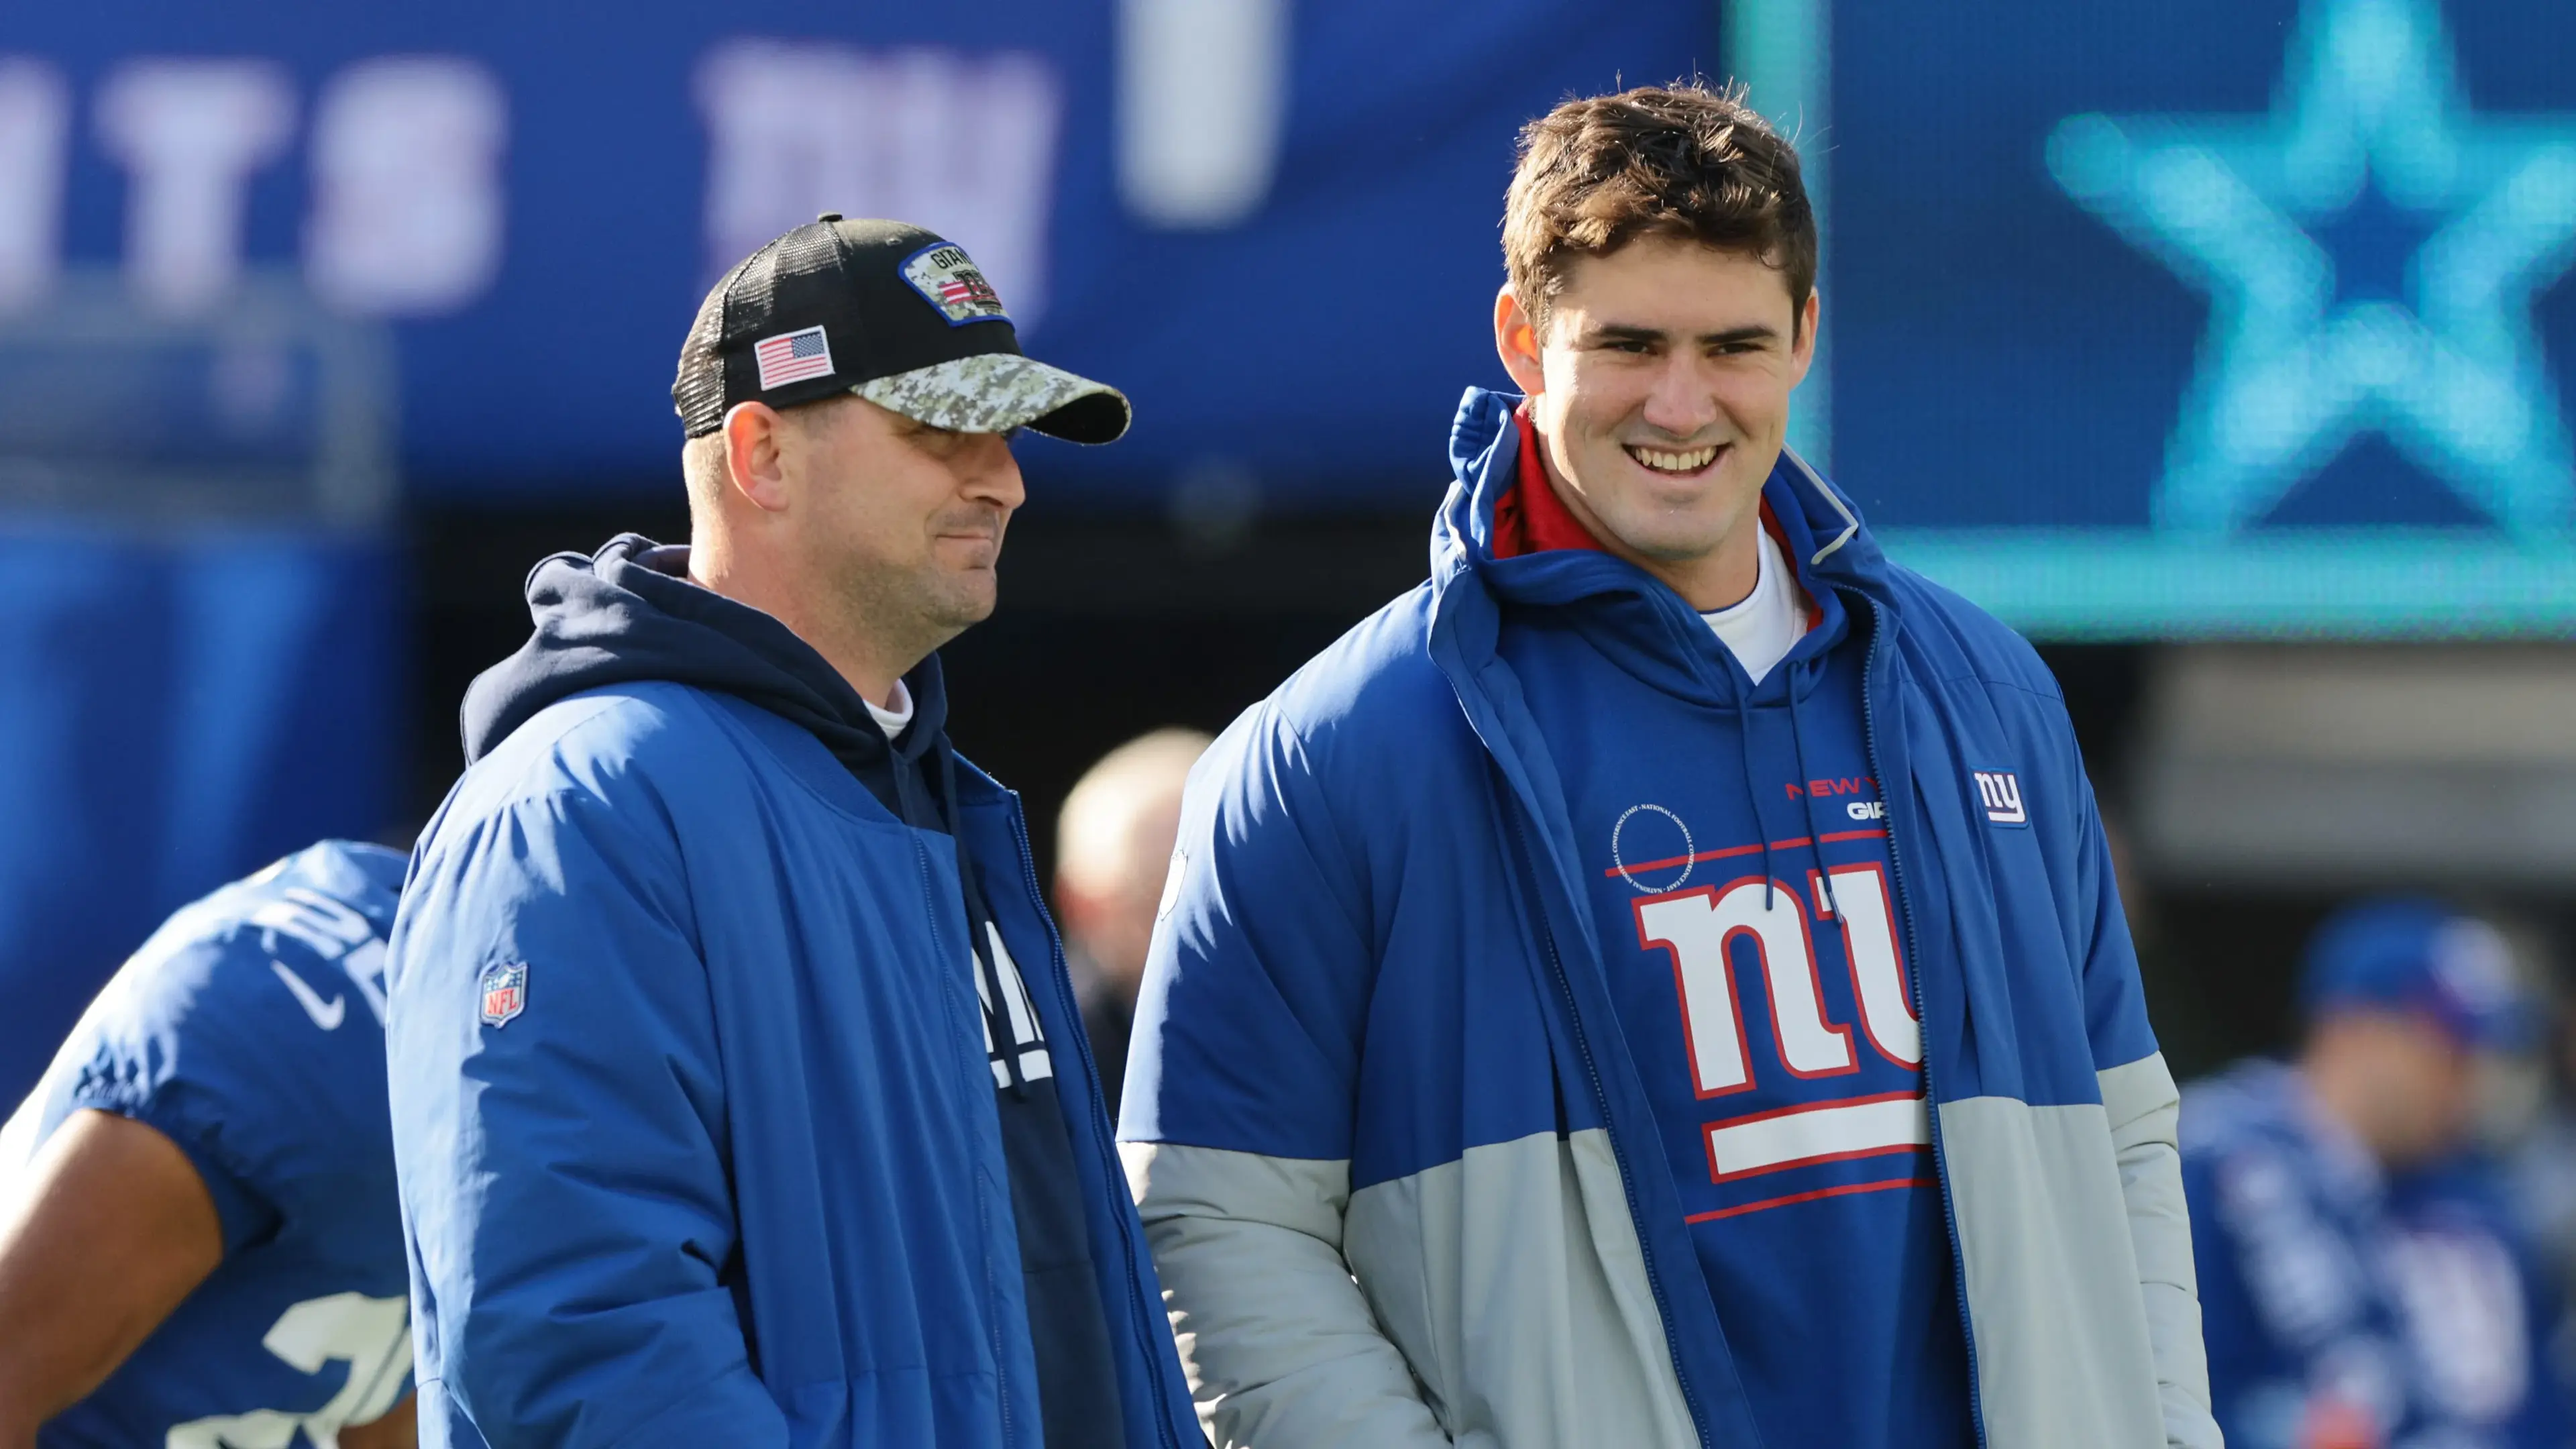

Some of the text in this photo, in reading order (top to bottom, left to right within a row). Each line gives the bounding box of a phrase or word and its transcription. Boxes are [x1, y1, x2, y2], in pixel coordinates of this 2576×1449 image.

[1785, 777, 1860, 800] NEW
[1974, 772, 2026, 822] ny
[1624, 805, 1638, 816] EAST
[1612, 813, 1626, 853] CONFERENCE
[1641, 804, 1695, 892] NATIONAL FOOTBALL CONFERENCE EAST
[1633, 881, 1663, 894] NATIONAL
[486, 988, 518, 1015] NFL
